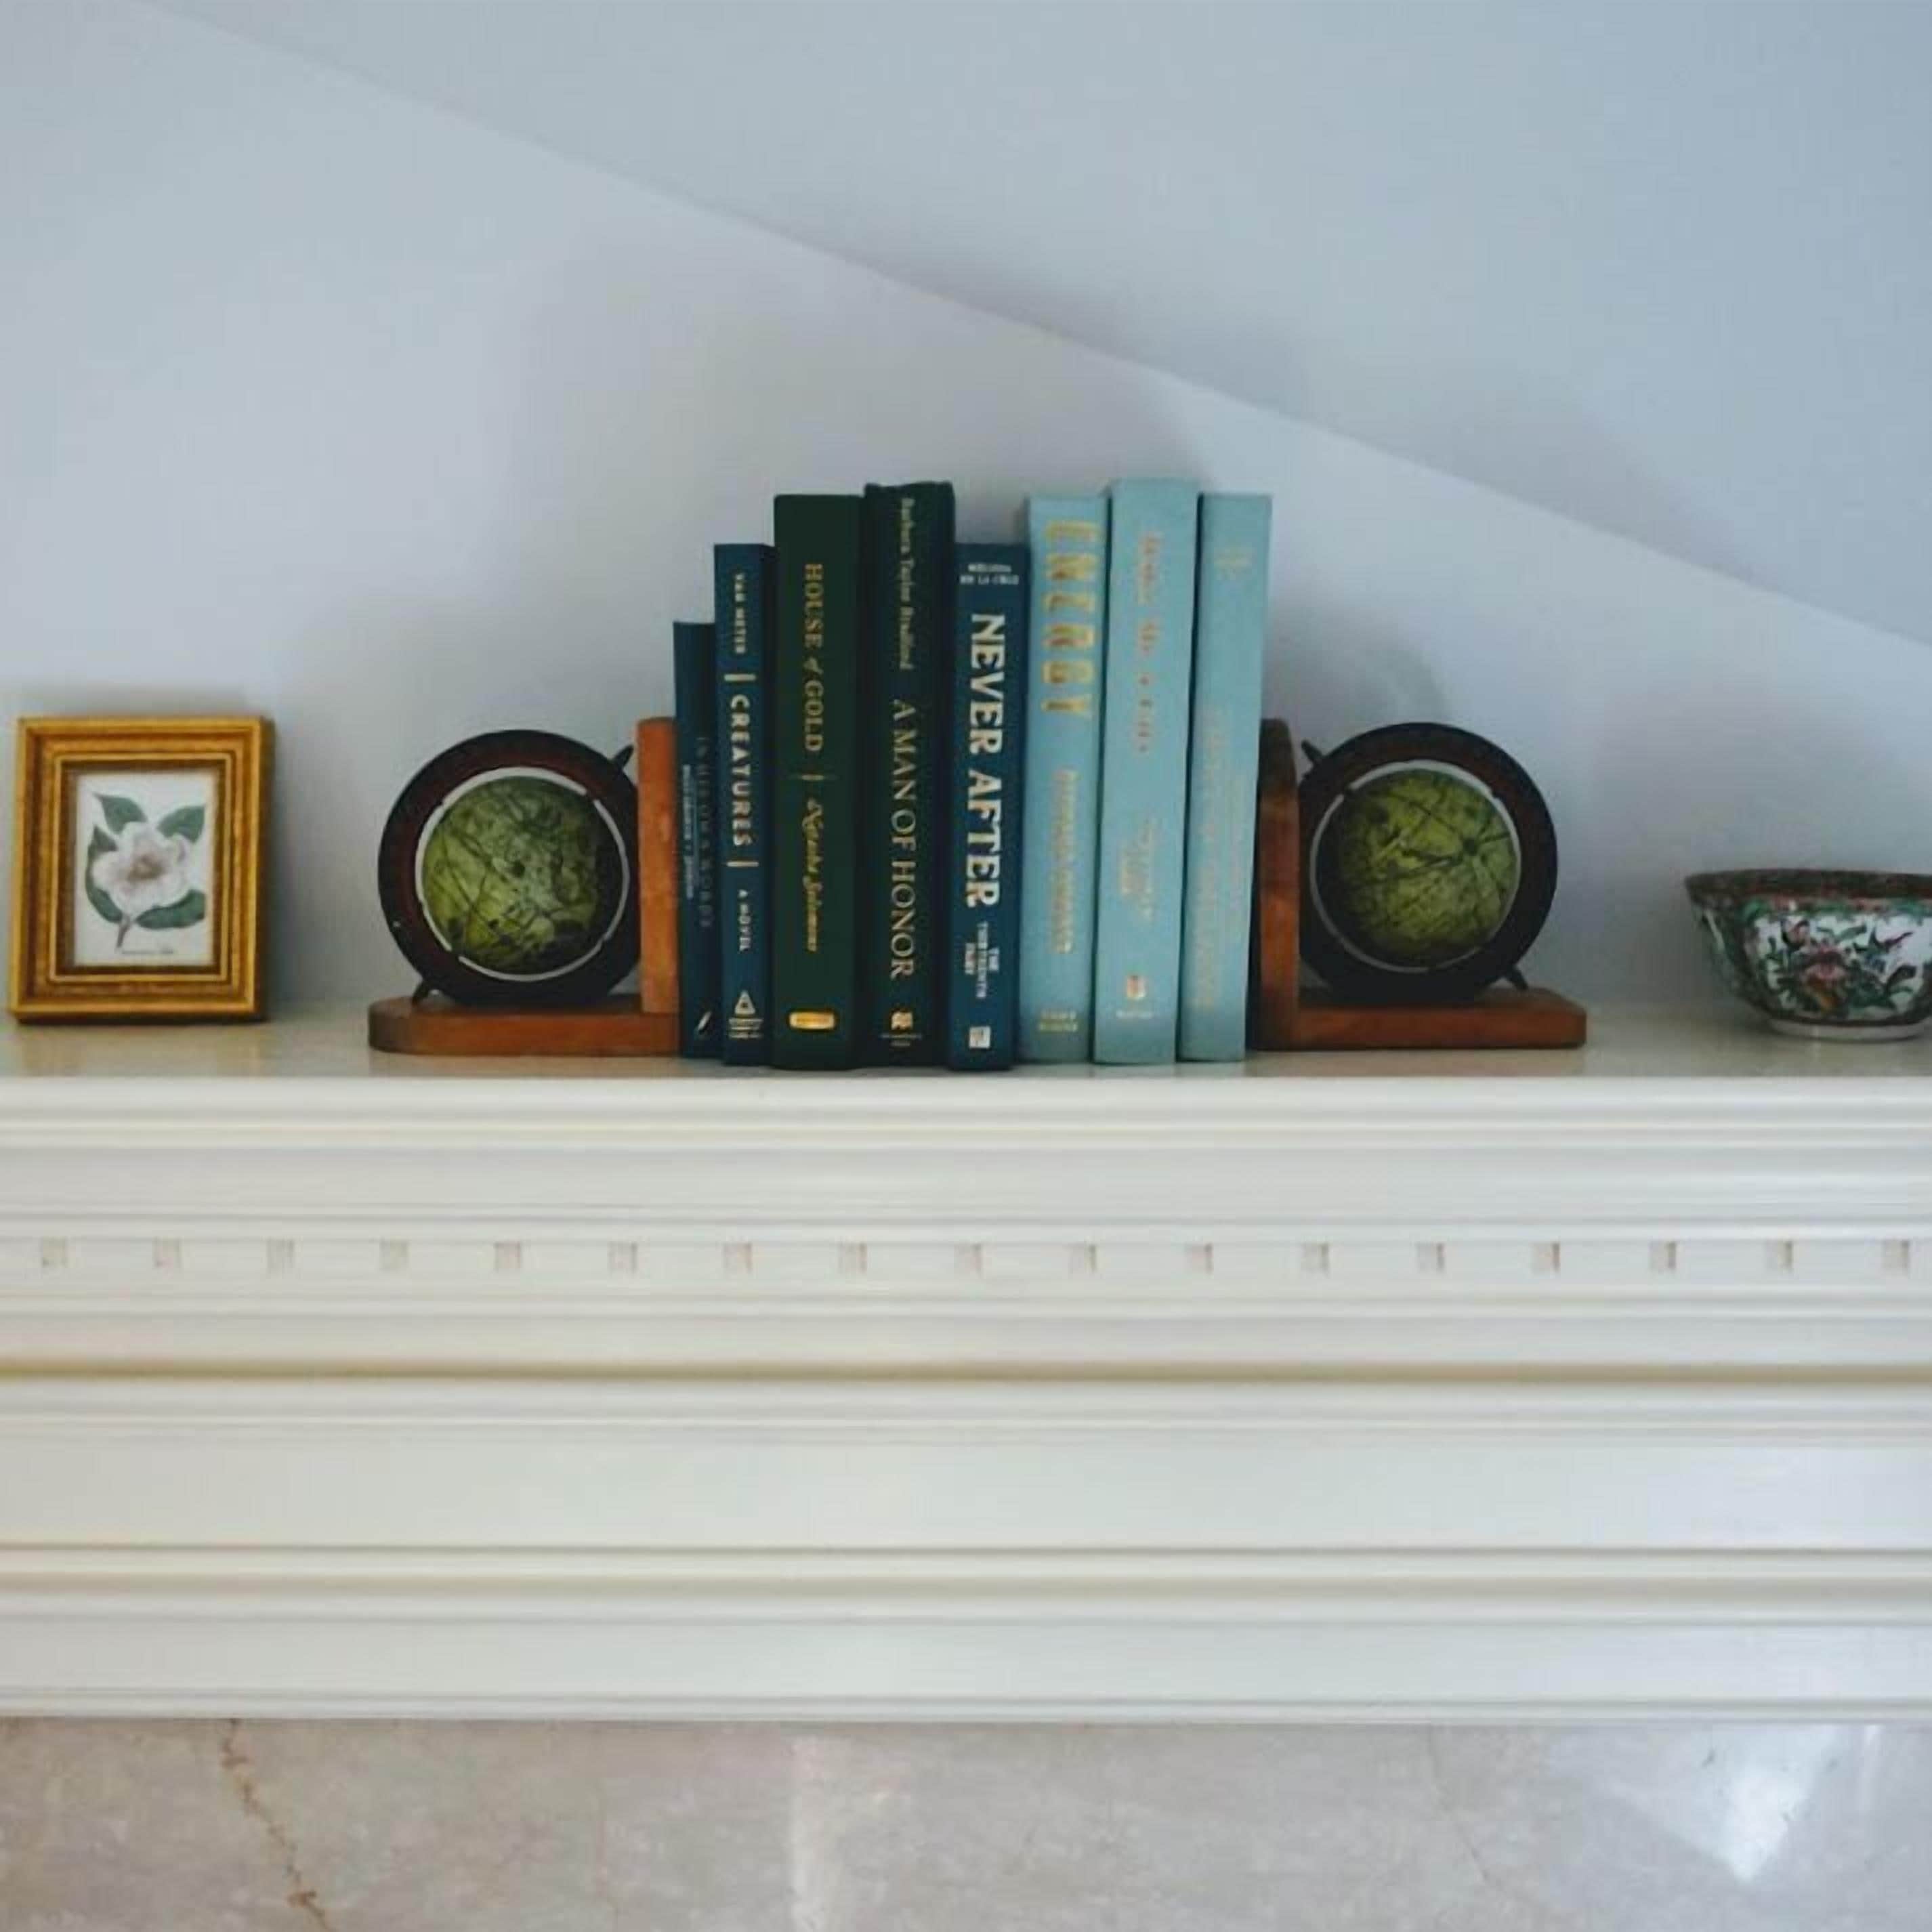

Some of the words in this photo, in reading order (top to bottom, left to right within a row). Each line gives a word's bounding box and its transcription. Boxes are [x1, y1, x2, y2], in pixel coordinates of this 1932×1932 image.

[805, 563, 824, 648] HOUSE
[897, 558, 915, 602] Taylor
[1043, 522, 1099, 716] ENERGY
[805, 679, 824, 752] GOLD
[893, 699, 917, 721] A
[969, 613, 1005, 755] NEVER
[731, 694, 752, 846] CREATURES
[892, 728, 917, 801] MAN
[891, 809, 917, 852] OF
[966, 768, 1003, 908] AFTER
[738, 903, 751, 952] NOVEL
[889, 860, 916, 980] HONOR
